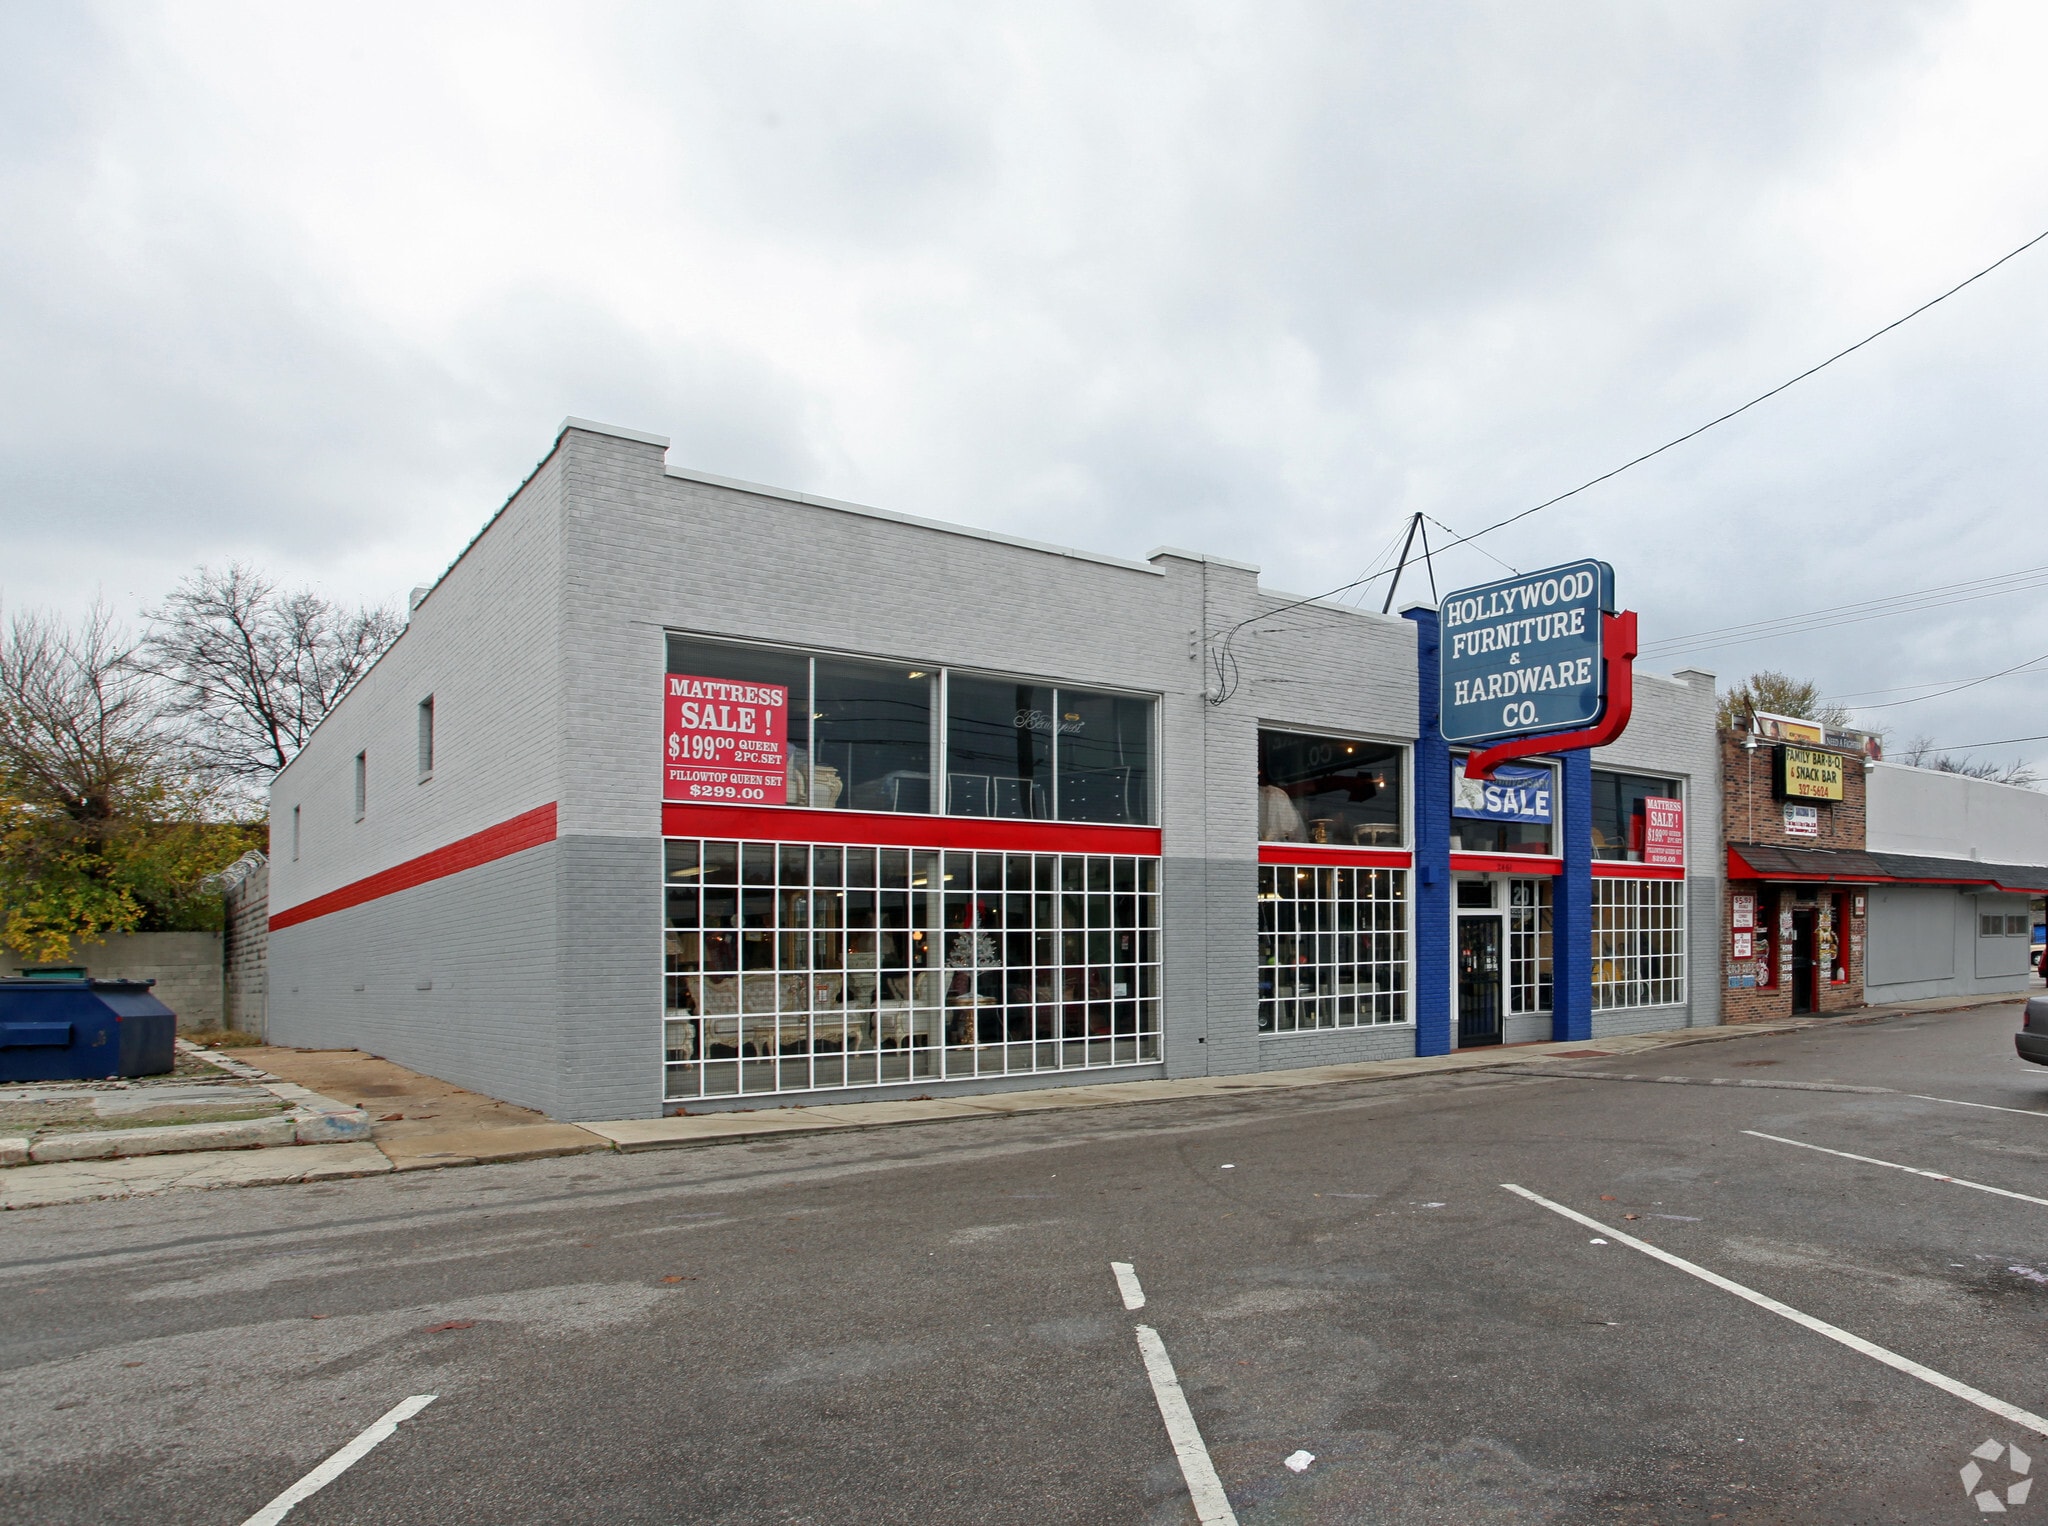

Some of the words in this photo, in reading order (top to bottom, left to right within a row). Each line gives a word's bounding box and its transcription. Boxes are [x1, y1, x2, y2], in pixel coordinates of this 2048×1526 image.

[1447, 571, 1594, 628] HOLLYWOOD
[1452, 607, 1585, 659] FURNITURE
[1509, 652, 1520, 665] &
[1454, 657, 1592, 706] HARDWARE
[669, 678, 783, 707] MATTRESS
[681, 701, 756, 734] SALE
[1502, 700, 1539, 727] CO.
[738, 739, 779, 752] QUEEN
[1786, 749, 1810, 764] FAMILY
[669, 769, 728, 783] PILLOWTOP
[730, 773, 762, 785] QUEEN
[764, 776, 783, 787] SET
[1796, 766, 1820, 780] SNACK
[1821, 770, 1837, 784] BAR
[689, 783, 764, 800] $299.00
[1485, 786, 1549, 816] SALE
[1647, 799, 1682, 812] MATTRESS
[1651, 811, 1674, 828] SALE
